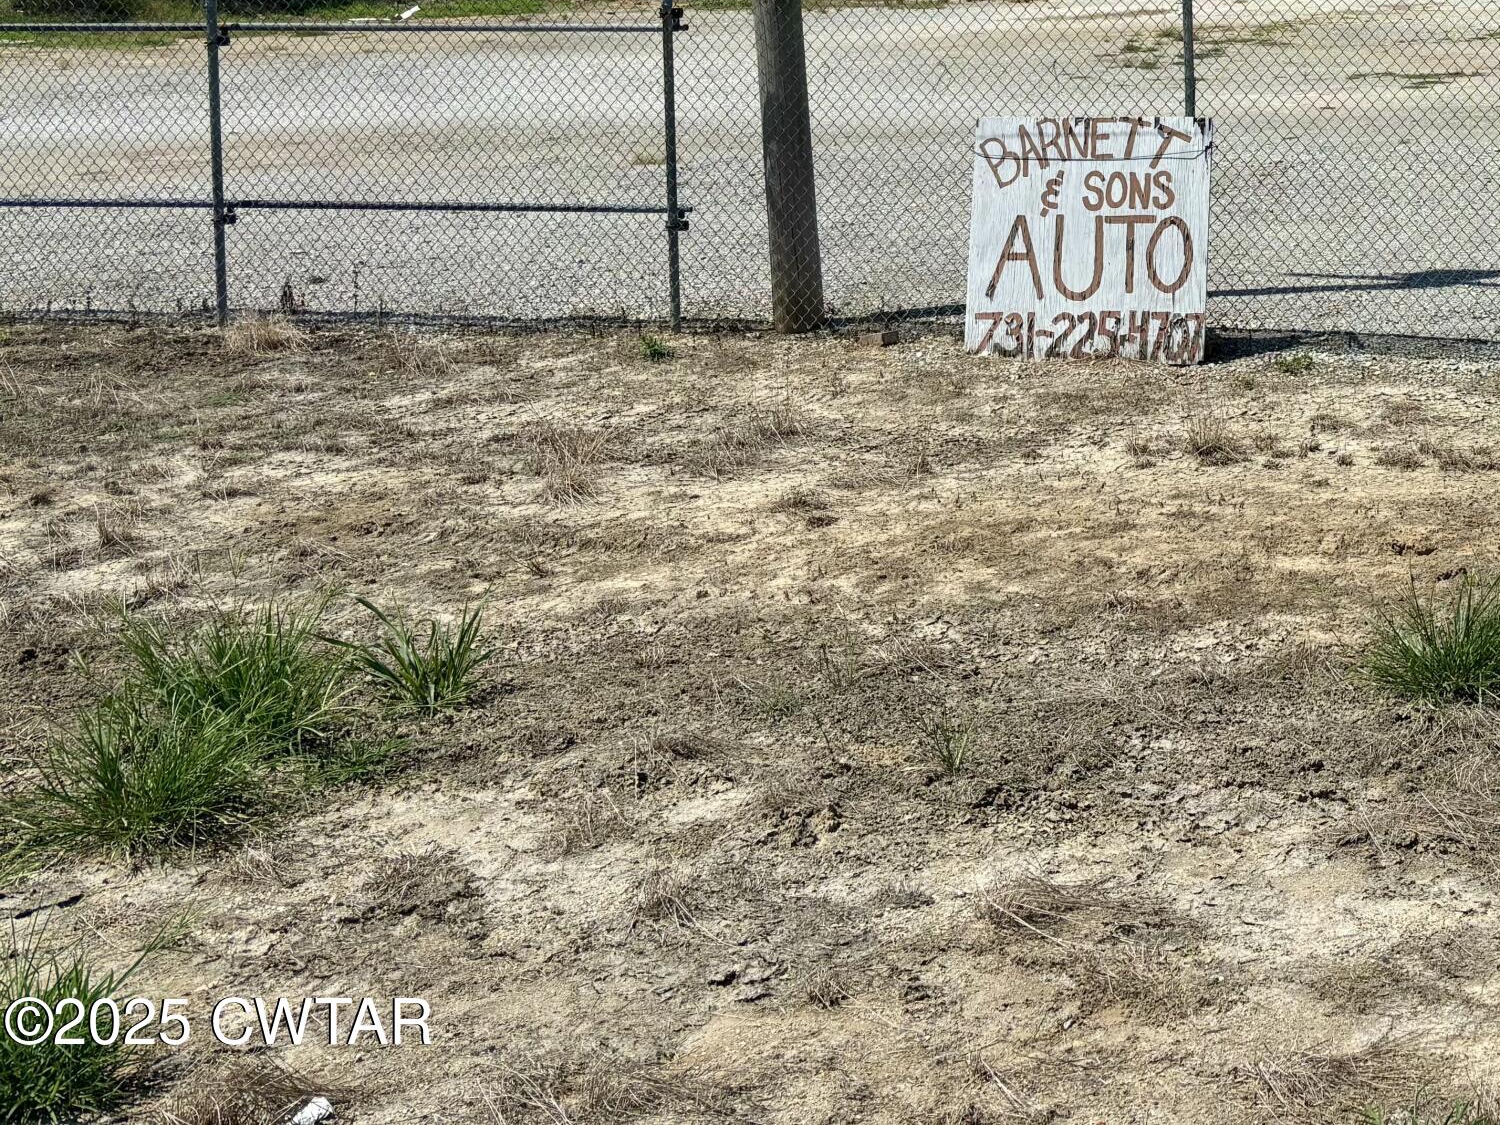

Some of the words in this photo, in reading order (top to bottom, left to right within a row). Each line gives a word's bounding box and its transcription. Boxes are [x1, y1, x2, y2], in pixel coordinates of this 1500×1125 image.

[979, 118, 1193, 189] BARNETT
[1040, 170, 1064, 217] &
[1082, 170, 1176, 212] SONS
[985, 214, 1194, 302] AUTO
